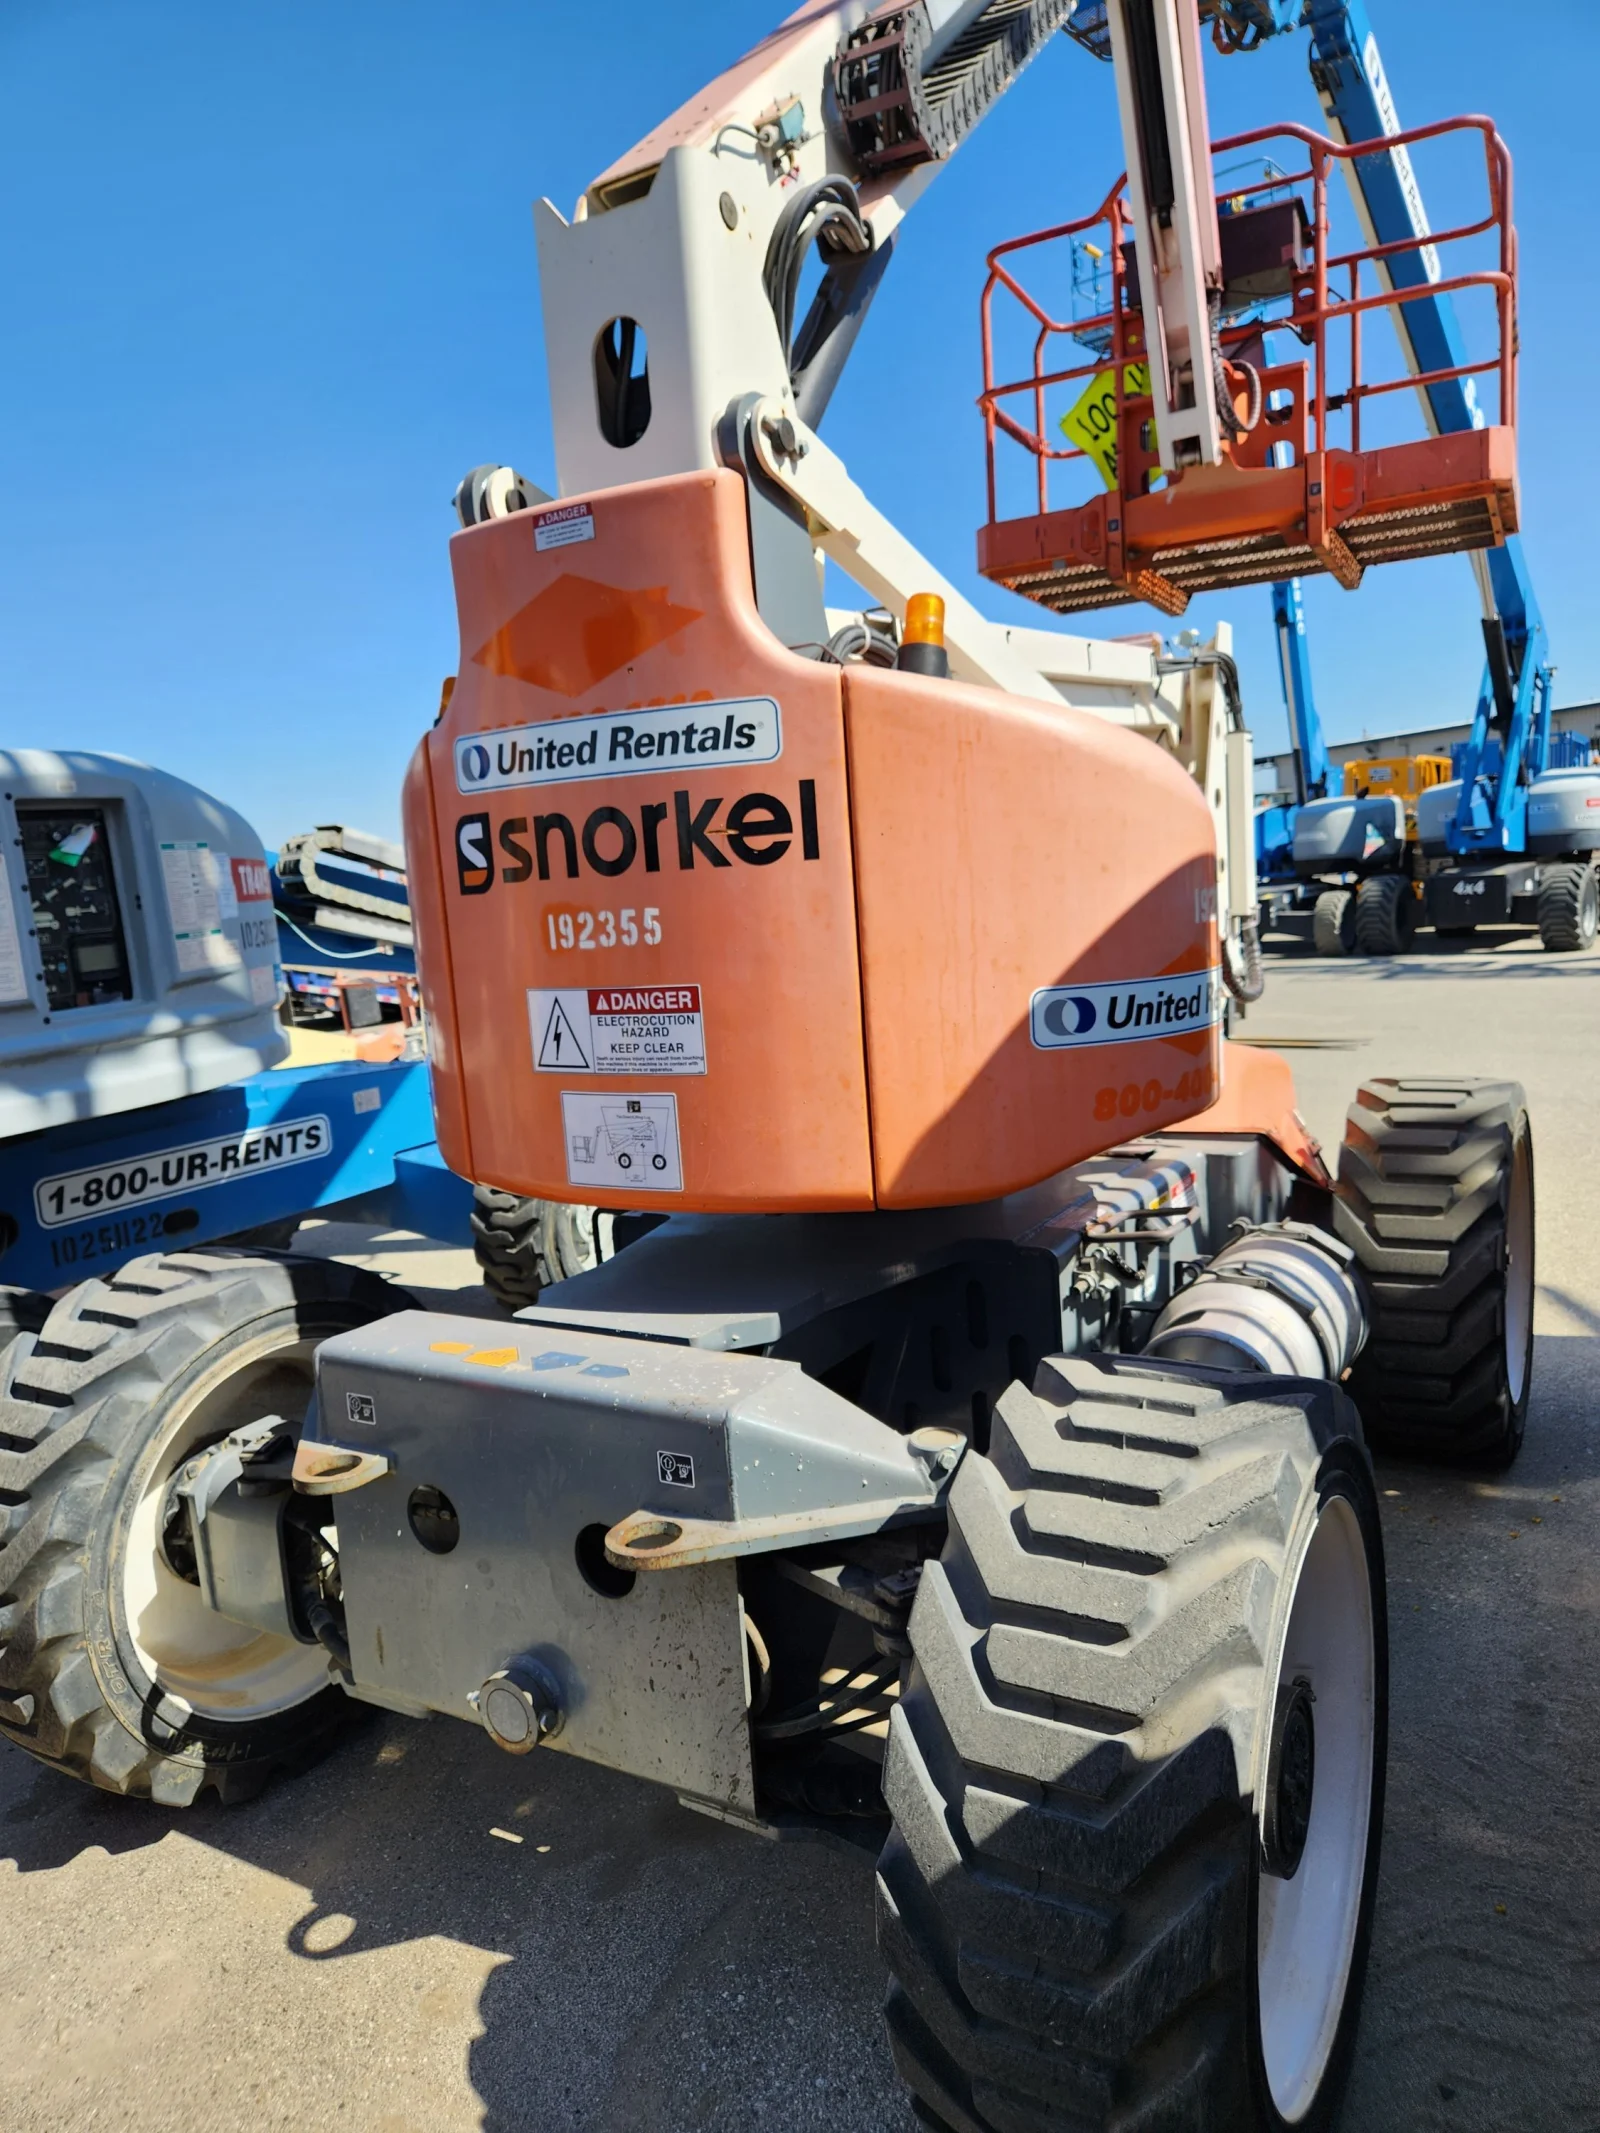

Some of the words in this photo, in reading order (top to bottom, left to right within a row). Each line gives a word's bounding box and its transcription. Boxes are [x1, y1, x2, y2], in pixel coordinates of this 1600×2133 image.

[545, 504, 588, 525] DANGER
[496, 729, 598, 776] United
[608, 714, 757, 762] Rentals
[498, 778, 820, 884] snorkel
[547, 907, 663, 951] 192355
[596, 1014, 695, 1027] ELECTROCUTION
[609, 990, 693, 1011] DANGER
[1106, 984, 1202, 1030] United
[610, 1043, 640, 1054] KEEP
[643, 1042, 684, 1054] CLEAR
[621, 1026, 670, 1038] HAZARD
[47, 1124, 322, 1215] 1-800-UR-RENTS
[51, 1211, 164, 1268] 10251122
